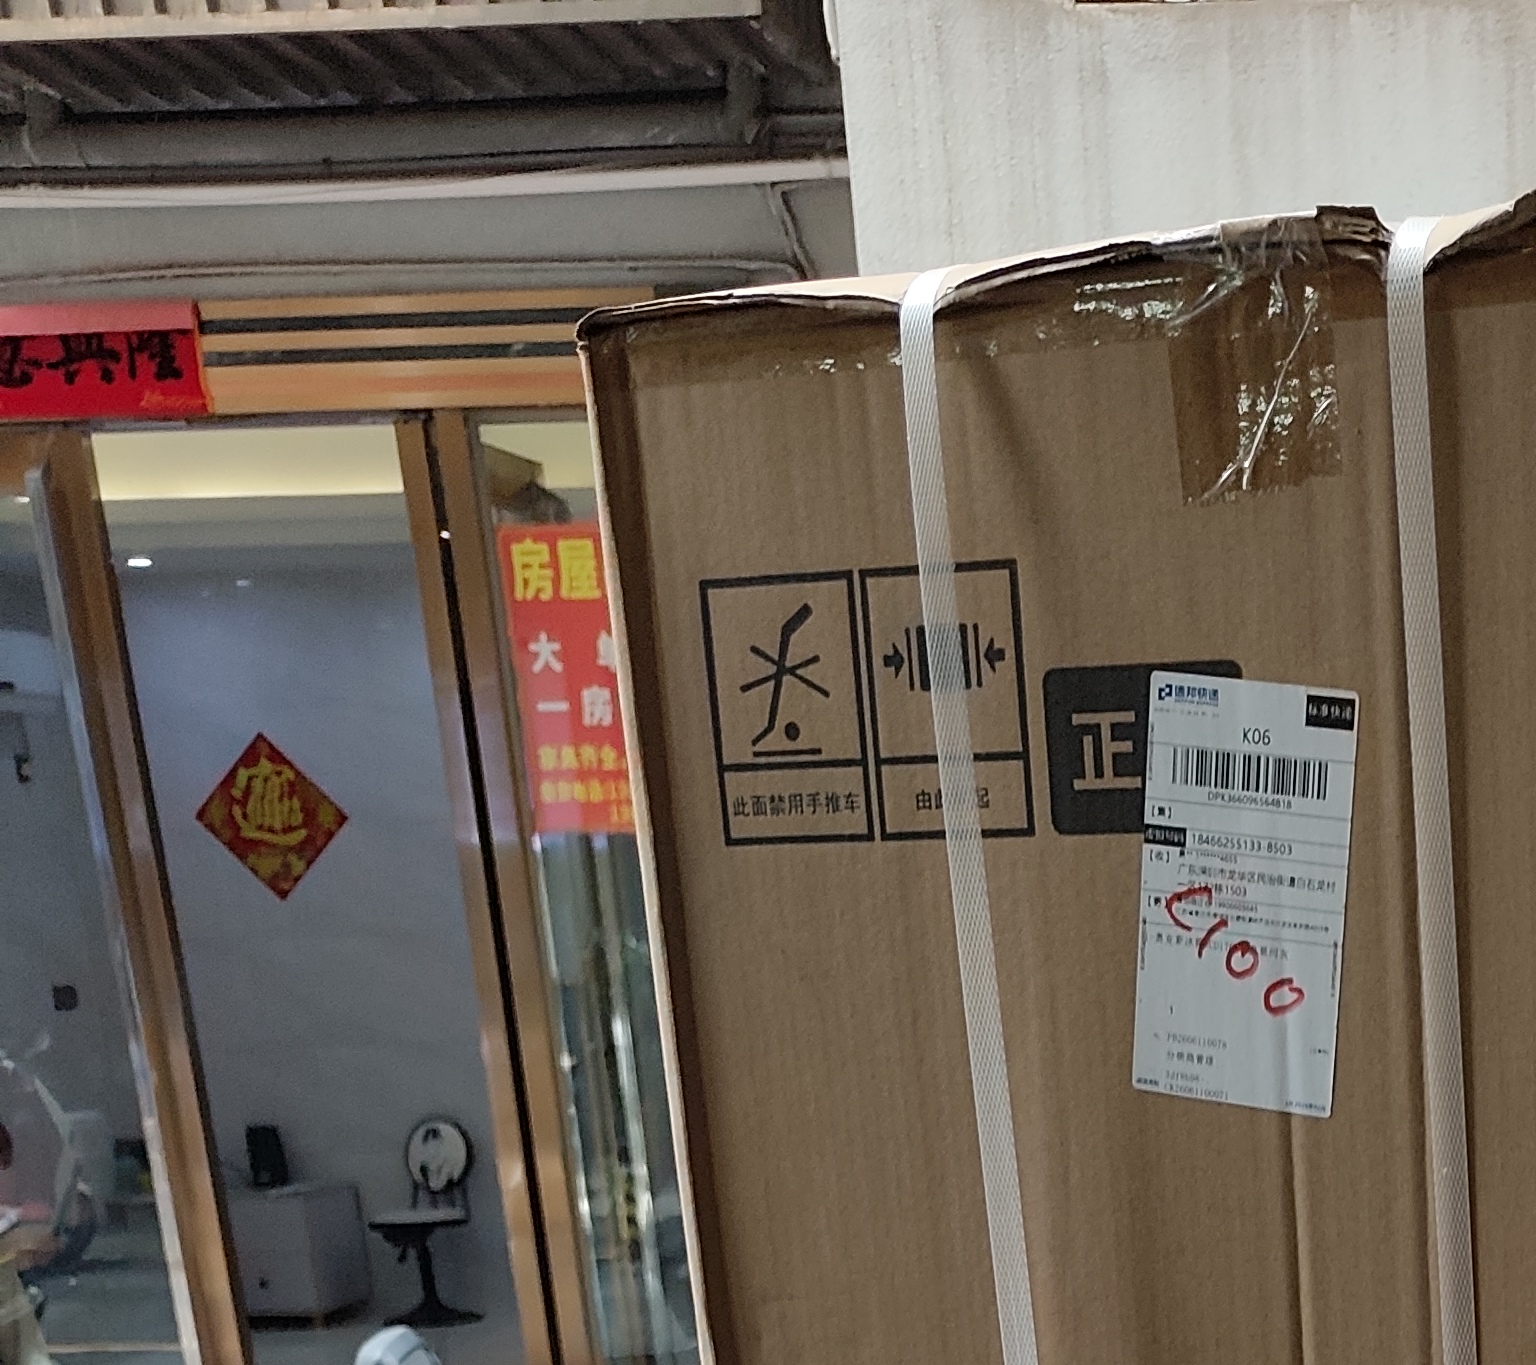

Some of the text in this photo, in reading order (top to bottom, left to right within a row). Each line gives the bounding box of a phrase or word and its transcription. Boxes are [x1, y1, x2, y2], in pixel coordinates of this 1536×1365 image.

[511, 537, 602, 601] 房屋
[1071, 710, 1143, 791] 正
[1242, 727, 1271, 746] K06
[732, 791, 861, 818] 此面禁用手推车
